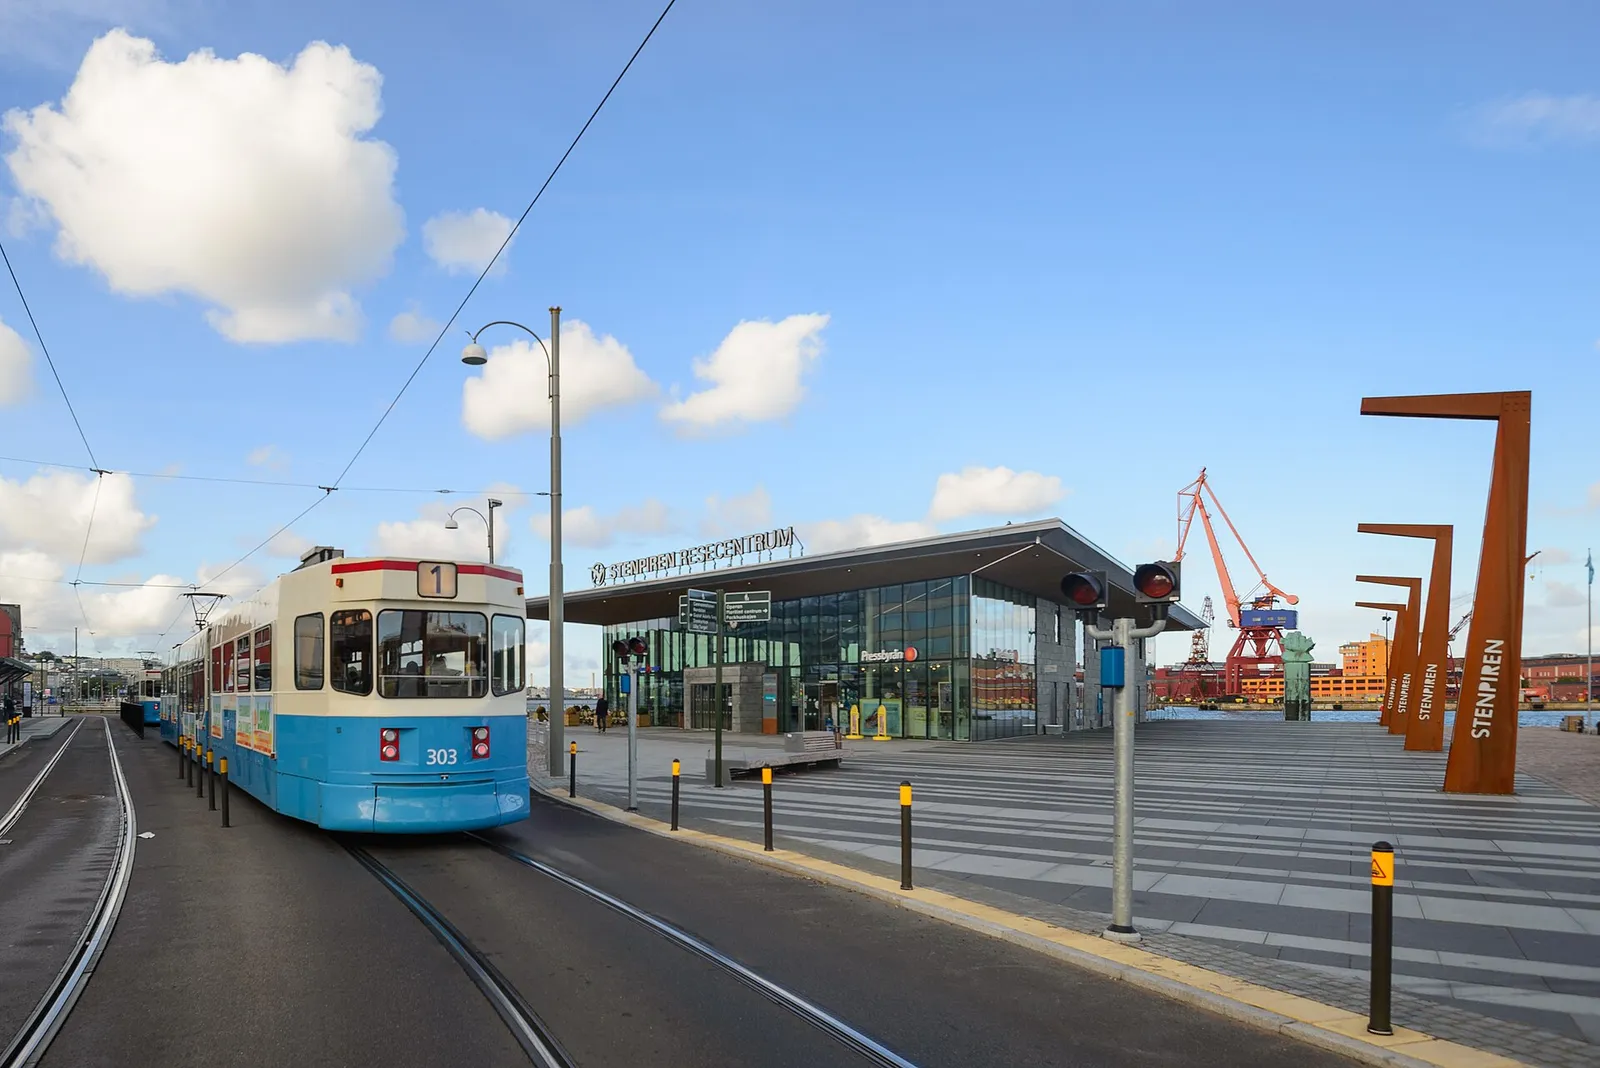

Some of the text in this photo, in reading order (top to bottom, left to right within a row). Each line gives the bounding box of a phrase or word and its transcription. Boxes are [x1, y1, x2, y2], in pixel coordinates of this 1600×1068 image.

[608, 526, 794, 580] STENPIREN RESECENTRUM
[430, 565, 441, 594] 1
[861, 648, 904, 662] Pressbyrån
[1397, 673, 1412, 714] STENPIREN
[1418, 663, 1438, 721] STENPIREN
[1470, 639, 1505, 739] STENPIREN
[426, 748, 457, 765] 303
